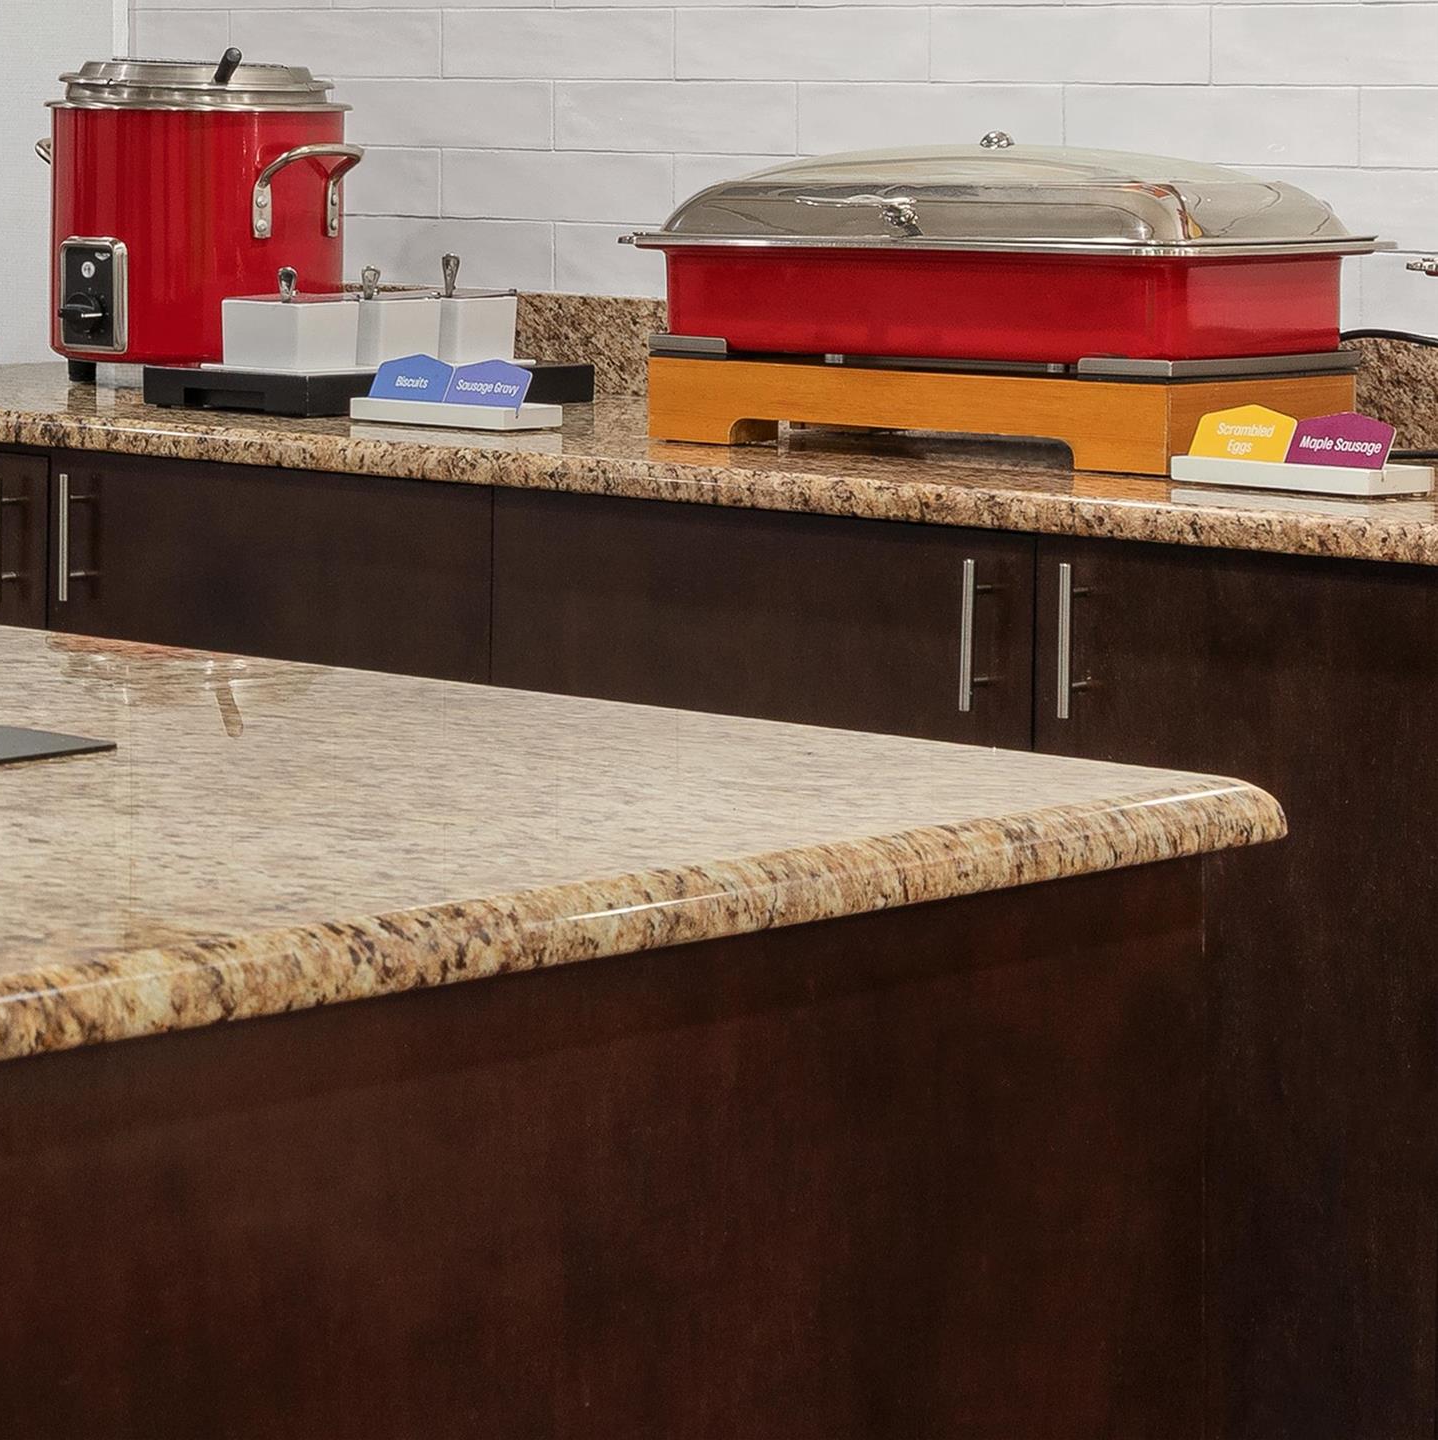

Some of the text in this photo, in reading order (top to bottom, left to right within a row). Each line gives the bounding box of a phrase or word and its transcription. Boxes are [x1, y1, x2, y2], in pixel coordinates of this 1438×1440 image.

[394, 375, 430, 389] Biscuits
[456, 379, 521, 397] Sausage Gravy
[1217, 422, 1276, 438] Scrambled
[1226, 439, 1254, 454] Eggs
[1298, 435, 1383, 457] Maple Sausage
